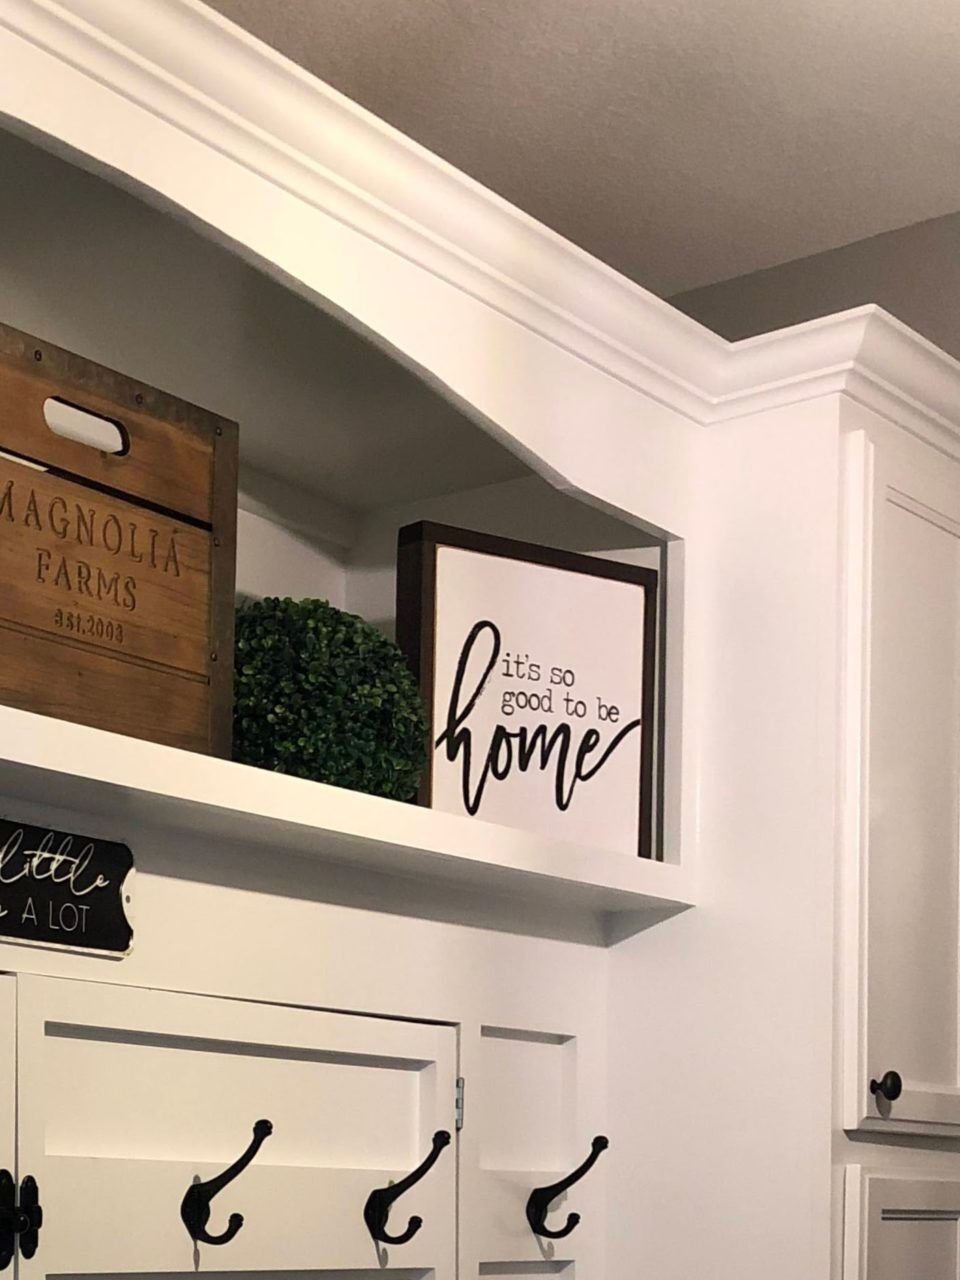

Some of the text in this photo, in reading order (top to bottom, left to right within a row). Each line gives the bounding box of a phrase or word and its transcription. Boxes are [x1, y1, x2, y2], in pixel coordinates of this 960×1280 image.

[36, 547, 137, 612] FARMS
[501, 652, 575, 687] it's so
[435, 620, 641, 817] home
[500, 688, 620, 723] good to be
[21, 897, 38, 926] A
[49, 901, 90, 933] LOT
